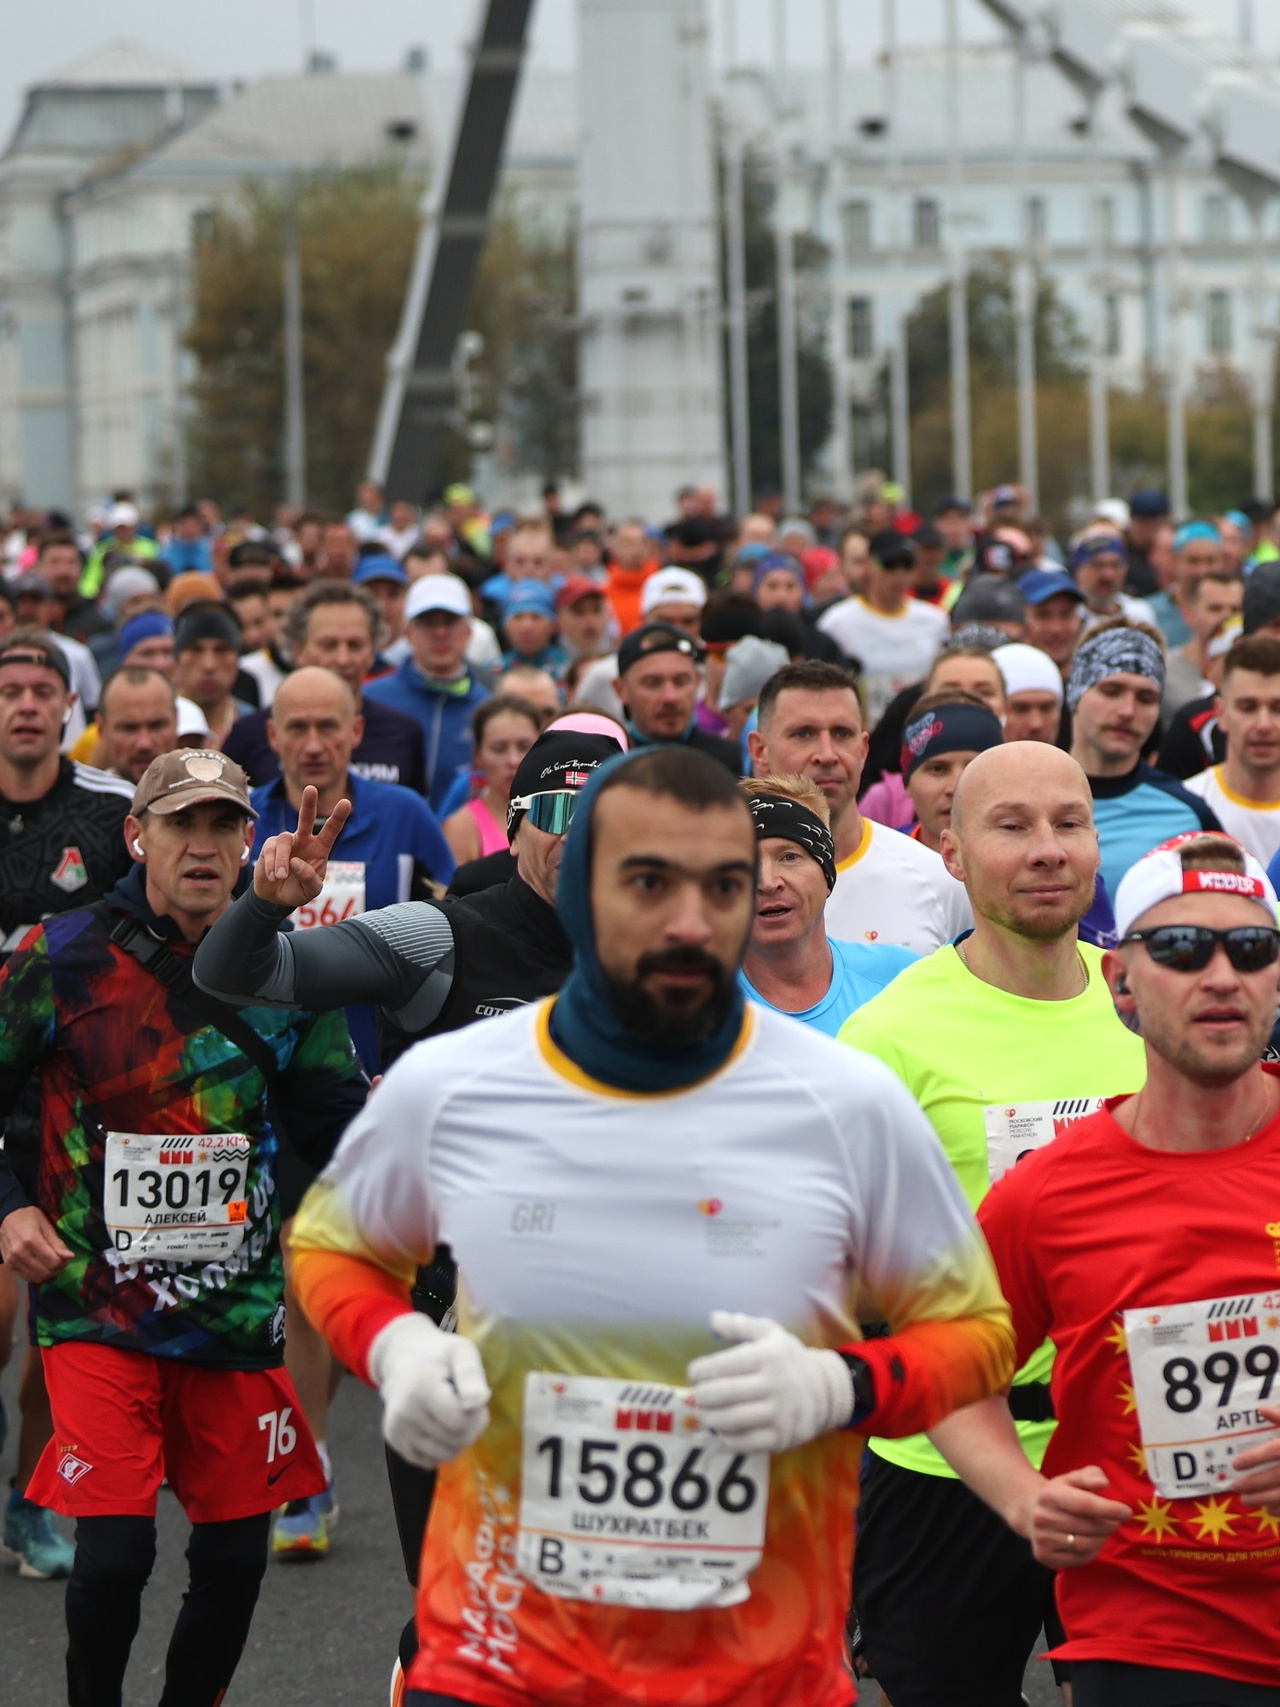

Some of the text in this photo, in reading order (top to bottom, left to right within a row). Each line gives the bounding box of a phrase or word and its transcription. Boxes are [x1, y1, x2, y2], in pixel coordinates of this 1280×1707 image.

[198, 1138, 225, 1149] 42,2
[113, 1168, 241, 1209] 13019
[144, 1210, 207, 1225] АЛЕКСЕЙ
[115, 1230, 133, 1251] D
[1216, 1409, 1272, 1431] АРТЕ
[258, 1408, 297, 1463] 76
[536, 1435, 757, 1515] 15866
[1173, 1452, 1198, 1481] D
[571, 1511, 710, 1538] ШУХРАТБЕК
[1169, 1549, 1225, 1561] ПРИМЕРОМ
[1226, 1552, 1249, 1562] ДЛЯ
